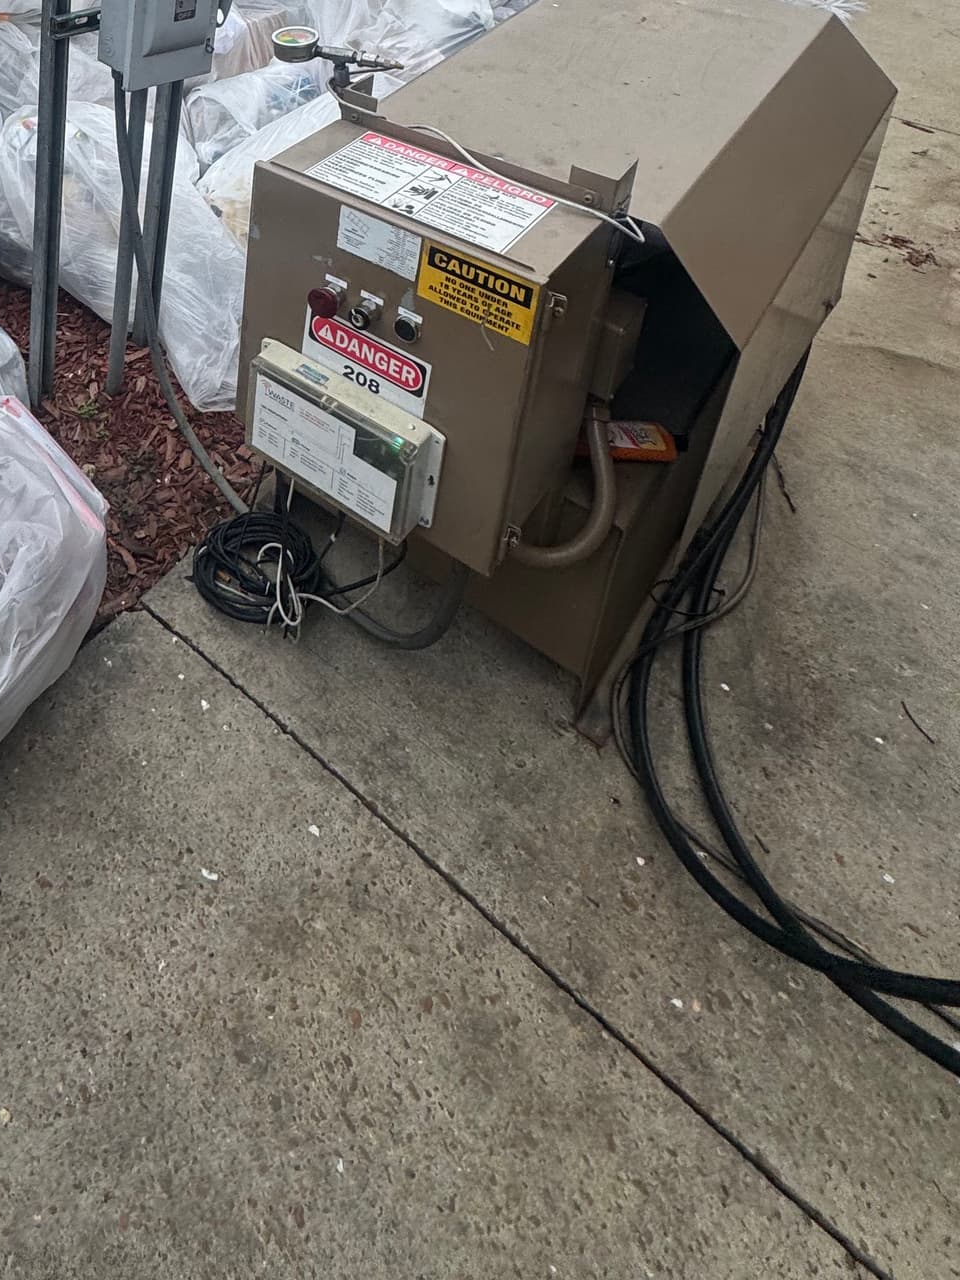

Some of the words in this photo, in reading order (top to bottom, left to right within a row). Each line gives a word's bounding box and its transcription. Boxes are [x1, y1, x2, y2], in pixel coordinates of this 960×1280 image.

[384, 140, 451, 169] DANGER
[470, 171, 548, 205] PELIGRO
[434, 253, 527, 302] CAUTION
[445, 276, 457, 286] NO
[459, 281, 476, 294] ONE
[478, 289, 508, 308] UNDER
[428, 284, 467, 308] ALLOWED
[470, 302, 480, 312] TO
[482, 308, 522, 331] OPERATE
[439, 282, 449, 290] 18
[452, 286, 479, 304] YEARS
[481, 299, 492, 309] OF
[495, 306, 513, 319] AGE
[439, 297, 458, 310] THIS
[460, 305, 510, 333] EQUIPMENT
[335, 329, 417, 387] DANGER
[342, 364, 381, 395] 208
[267, 388, 295, 409] WASTE
